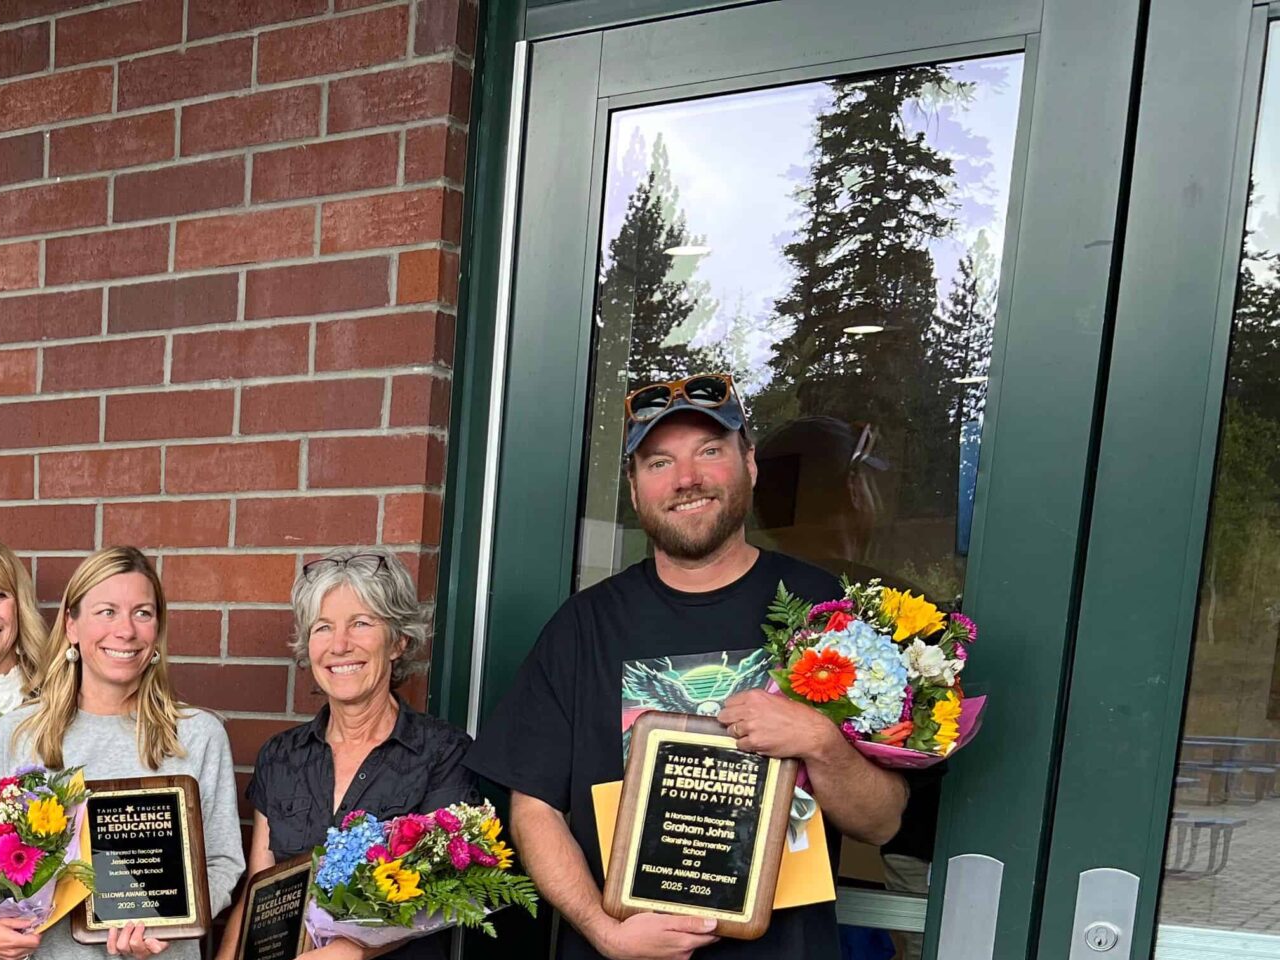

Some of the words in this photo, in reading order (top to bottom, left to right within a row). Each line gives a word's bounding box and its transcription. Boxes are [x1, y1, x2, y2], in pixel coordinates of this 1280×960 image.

[667, 755, 700, 765] TAHOE
[716, 760, 759, 772] TRUCKEE
[664, 763, 758, 785] EXCELLENCE
[662, 778, 675, 787] IN
[675, 777, 755, 797] EDUCATION
[660, 788, 753, 807] FOUNDATION
[97, 811, 172, 824] EXCELLENCE
[670, 812, 696, 822] Honored
[108, 821, 172, 832] EDUCATION
[663, 821, 704, 835] Graham
[705, 827, 735, 839] Johns
[97, 830, 173, 840] FOUNDATION
[682, 846, 707, 857] School
[692, 839, 731, 853] Elementary
[110, 858, 135, 866] Jessica
[136, 856, 161, 864] Jacobs
[682, 859, 693, 867] as
[130, 868, 144, 876] High
[641, 864, 673, 875] FELLOWS
[673, 869, 700, 879] AWARD
[701, 872, 737, 884] RECIPIENT
[125, 890, 148, 898] AWARD
[148, 888, 178, 896] RECIPIENT
[661, 880, 683, 891] 2025
[689, 884, 712, 895] 2026
[117, 901, 136, 909] 2025
[141, 900, 160, 908] 2026
[256, 889, 302, 913] EXCELLENCE
[260, 899, 300, 920] EDUCATION
[253, 910, 299, 930] FOUNDATION
